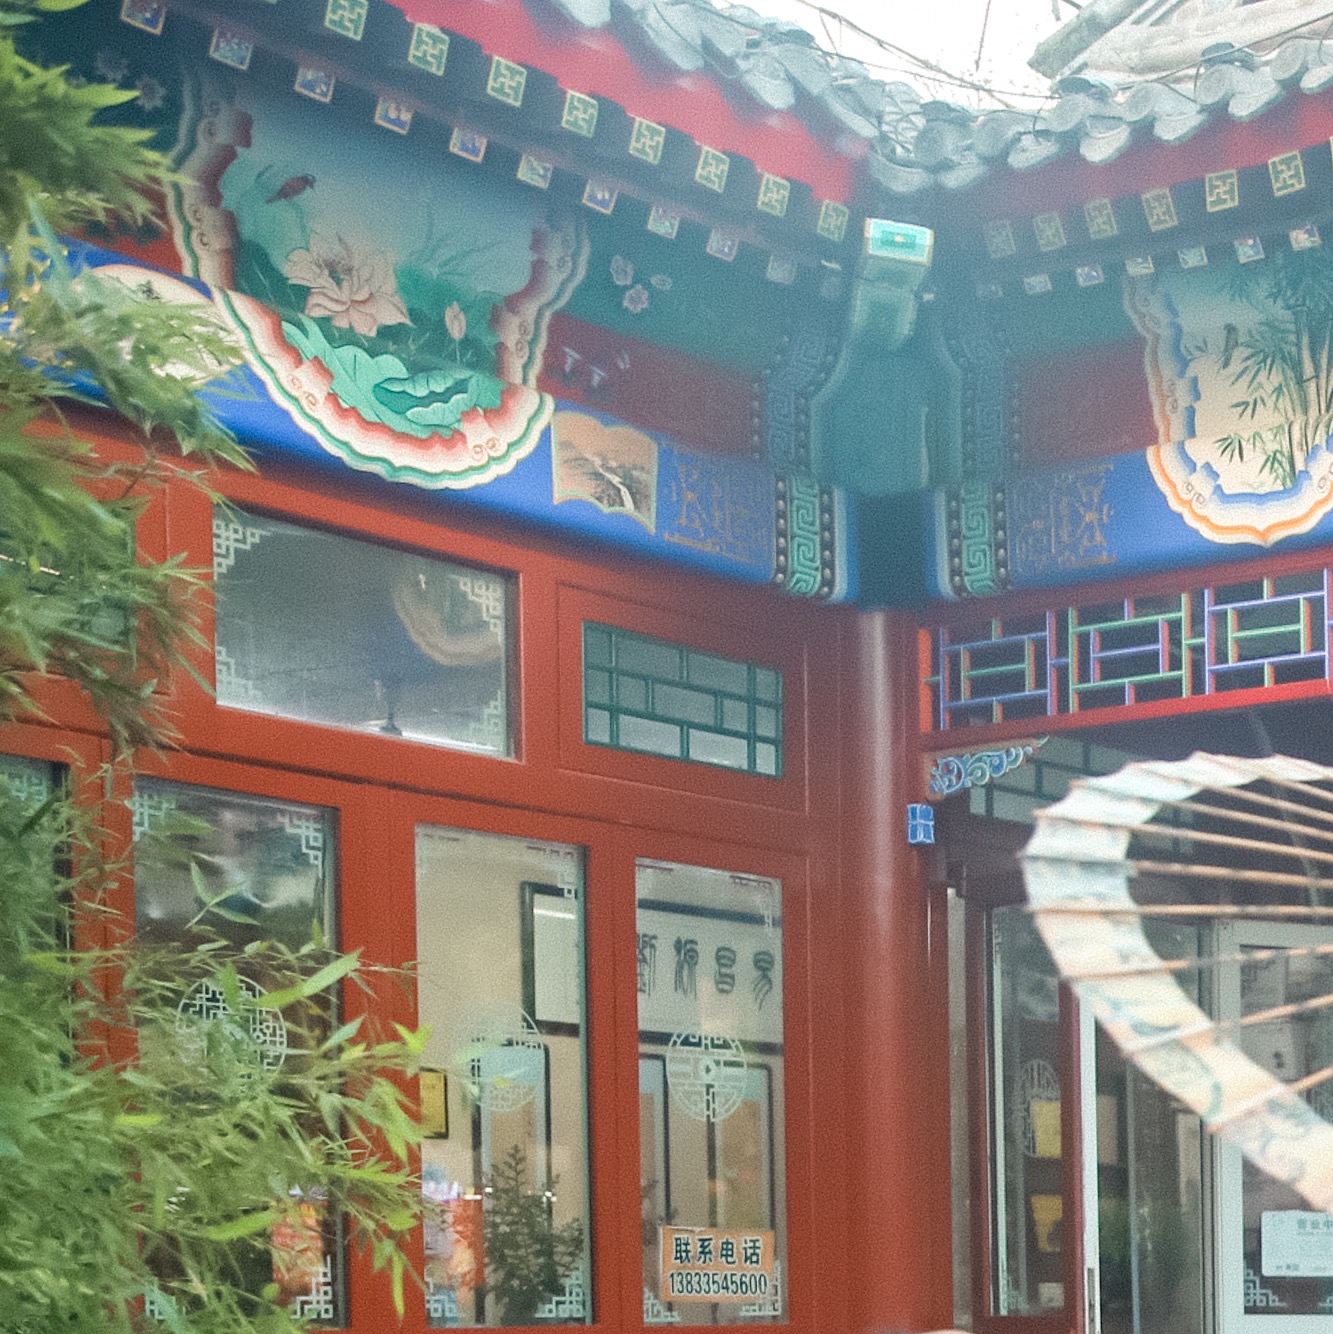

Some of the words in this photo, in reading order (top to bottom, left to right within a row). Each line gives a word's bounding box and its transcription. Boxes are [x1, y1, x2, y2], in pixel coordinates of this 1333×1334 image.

[674, 1236, 761, 1266] 联系电话
[669, 1271, 768, 1295] 13833545600
